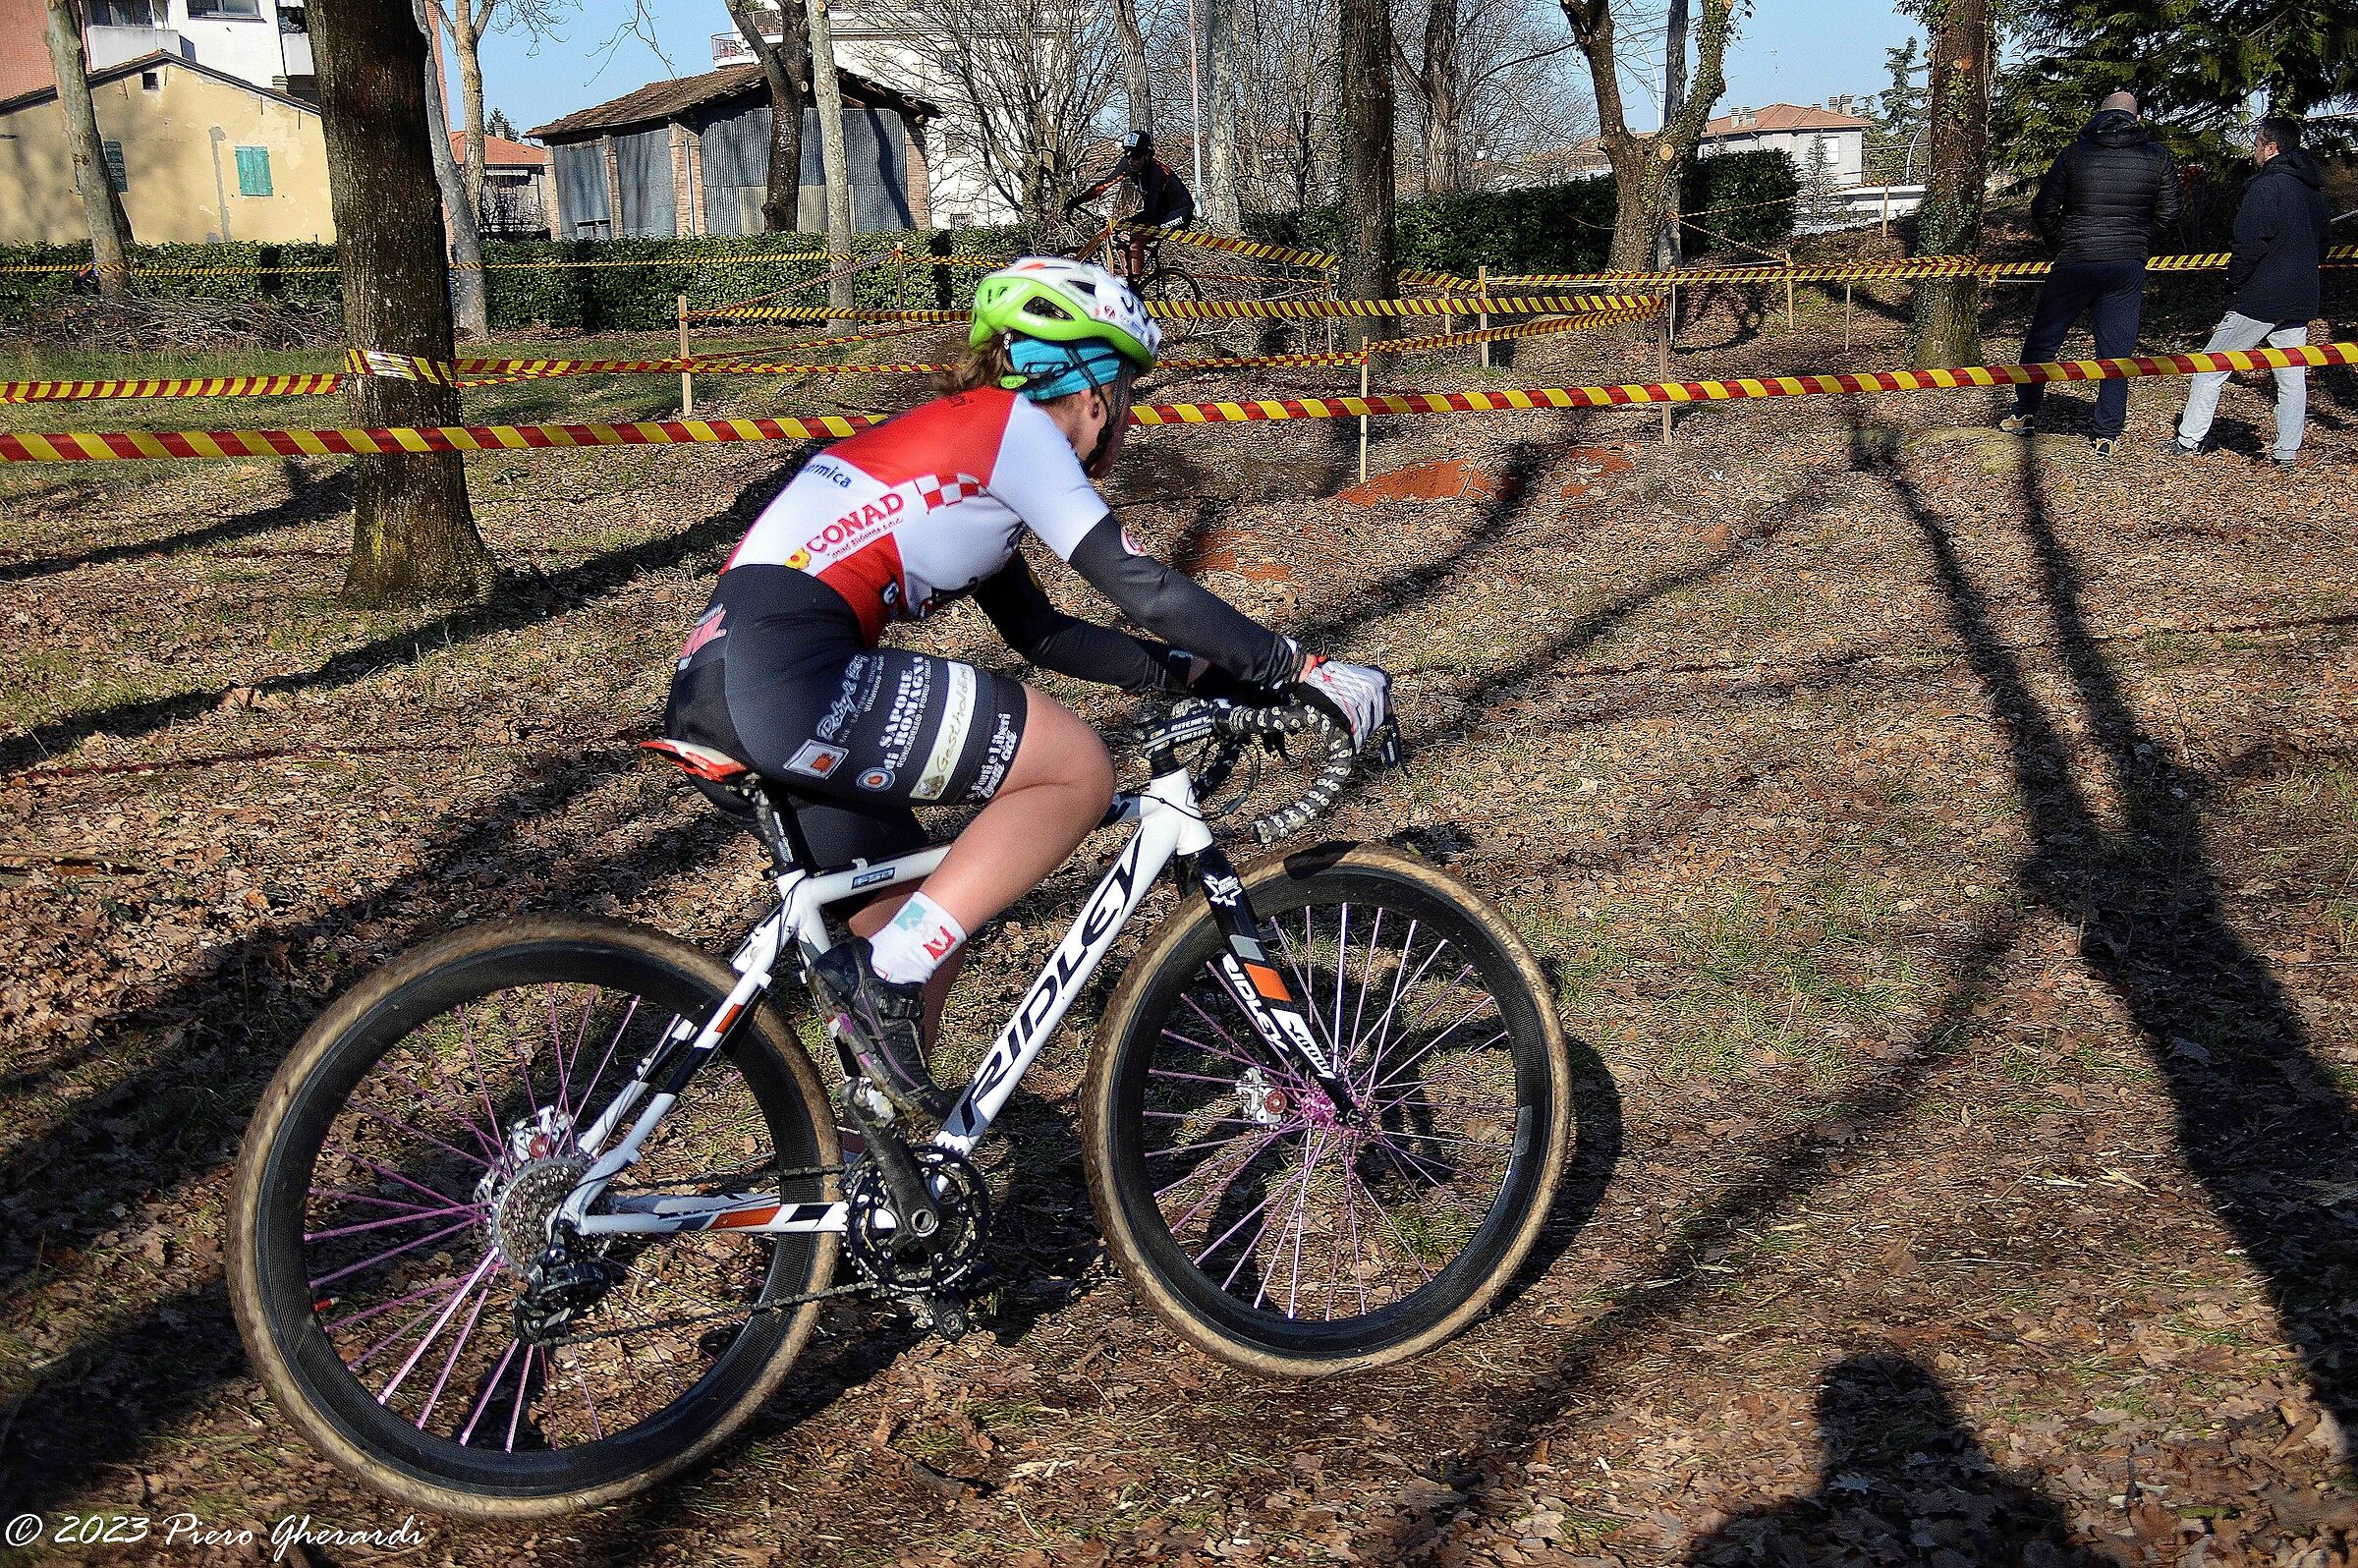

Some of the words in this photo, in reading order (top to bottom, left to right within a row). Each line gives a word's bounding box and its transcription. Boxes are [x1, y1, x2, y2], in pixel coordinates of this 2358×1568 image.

[806, 492, 905, 553] CONAD
[878, 669, 913, 749] SAPORE
[883, 753, 899, 770] di
[892, 656, 925, 746] ROMAGNA
[967, 826, 1145, 1110] RIDLEY
[1222, 953, 1290, 1053] RIDLEY
